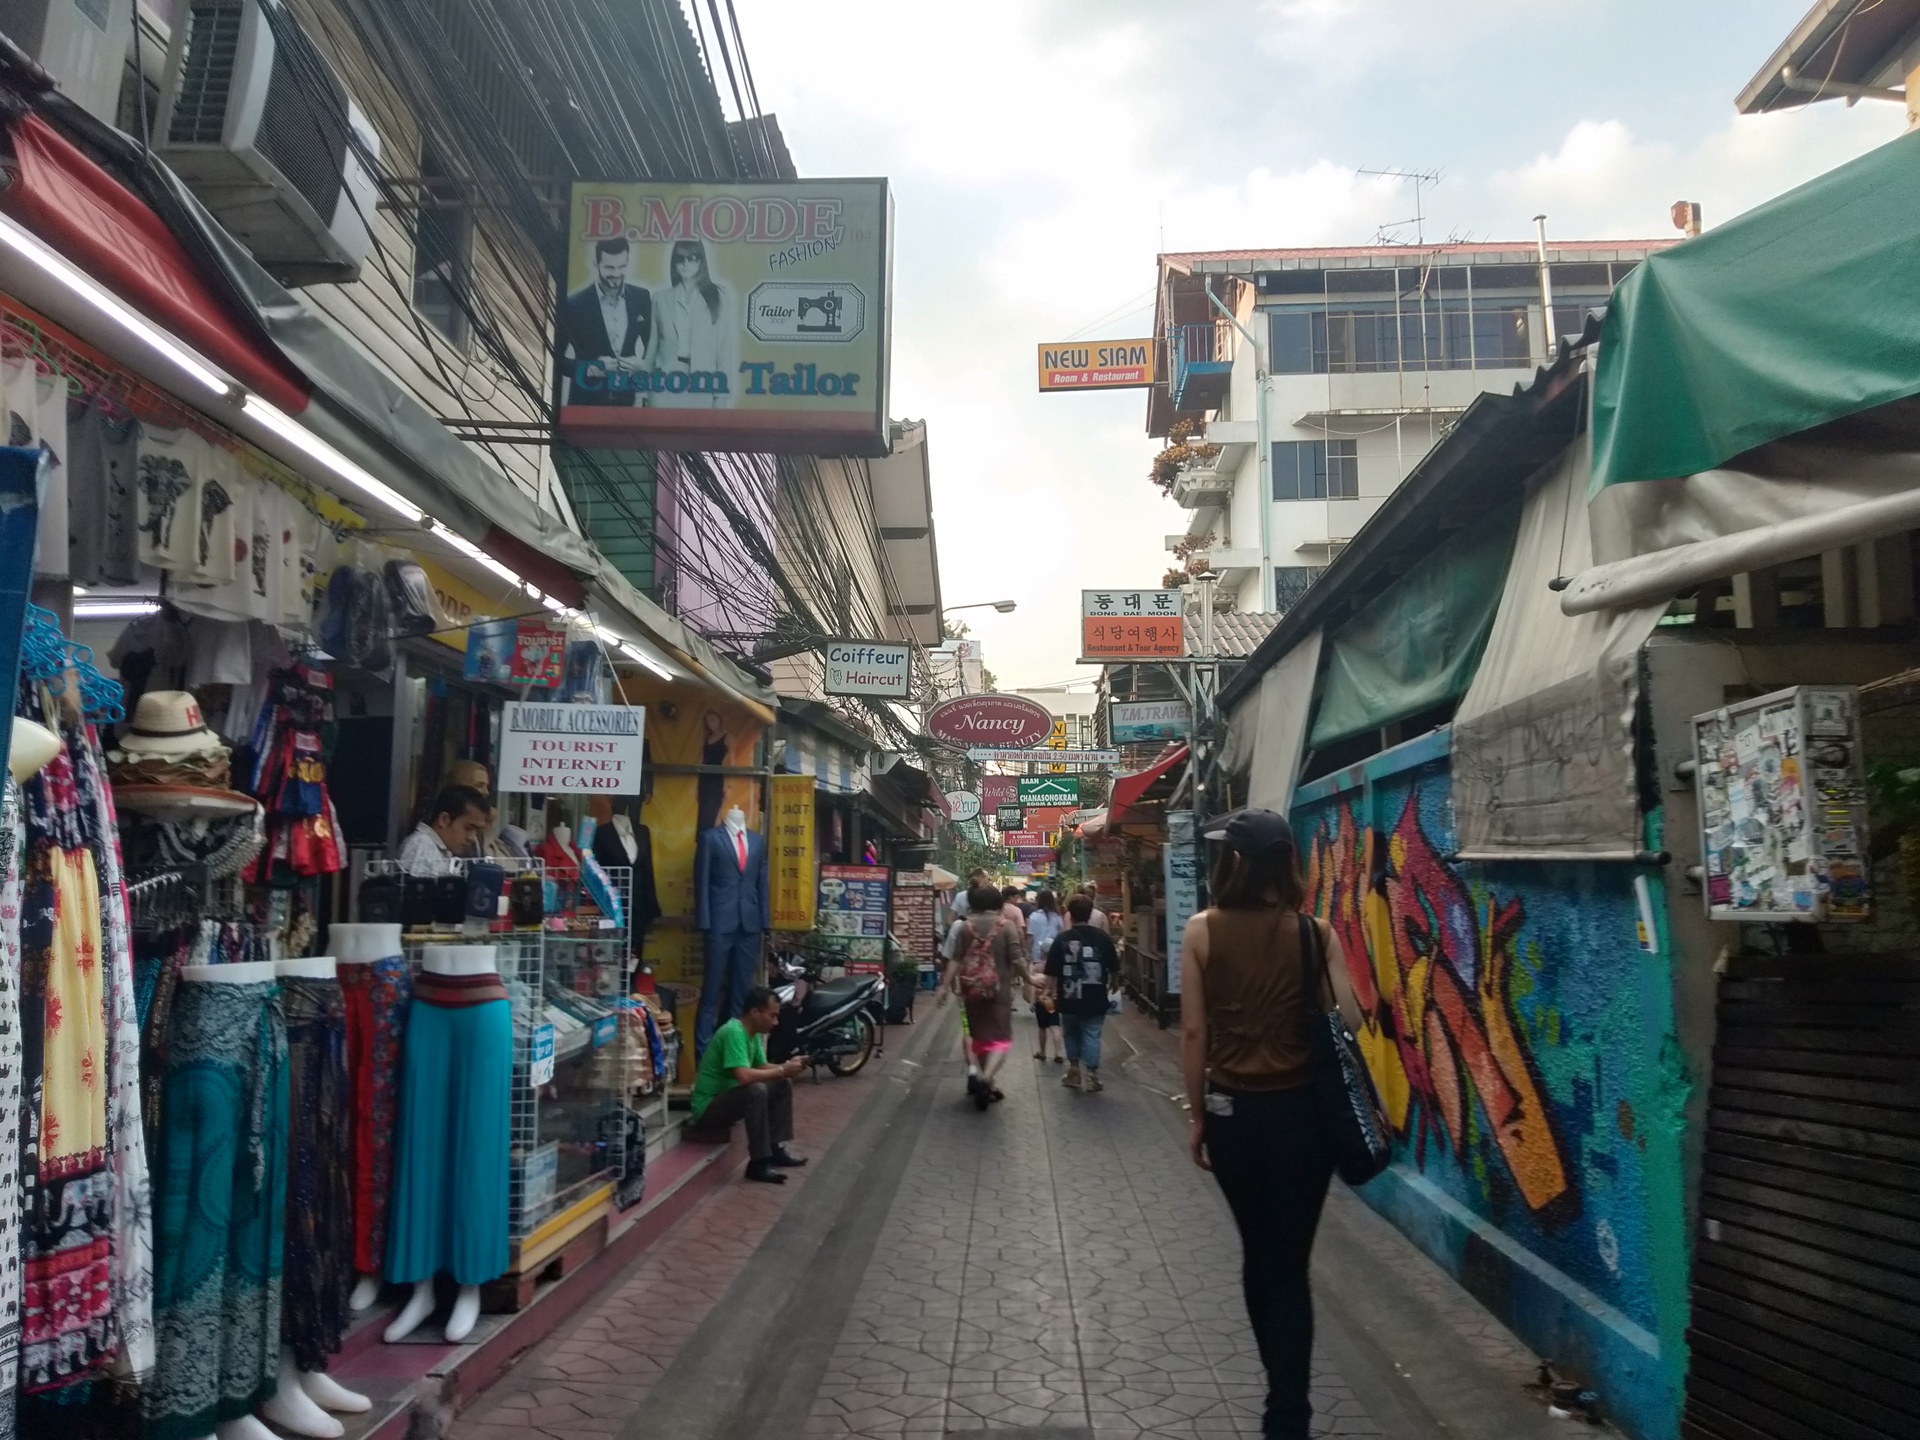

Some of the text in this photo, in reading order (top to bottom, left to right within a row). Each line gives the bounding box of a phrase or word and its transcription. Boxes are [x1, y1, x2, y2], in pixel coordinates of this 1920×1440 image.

[582, 195, 844, 244] B.MODE
[769, 234, 836, 272] FASHION
[758, 304, 796, 318] Tailor
[1044, 346, 1147, 369] NEW SIAM
[575, 359, 860, 398] Custom Tailor
[1054, 370, 1140, 384] Room & Restaurant
[1087, 643, 1180, 654] Restaurant & Tour Agency
[829, 648, 905, 666] Coiffeur
[846, 671, 904, 687] Haircut
[568, 708, 639, 734] ACCESSORIES
[954, 711, 1026, 735] Nancy
[936, 729, 985, 748] MASSAGE
[1000, 730, 1042, 748] BEAUTY
[529, 740, 618, 754] TOURIST
[522, 757, 626, 771] INTERNET
[1053, 752, 1067, 761] 2.50
[518, 774, 620, 789] SIM CARD
[984, 787, 1005, 797] Wild
[1019, 794, 1078, 802] CHANASONGKRAM
